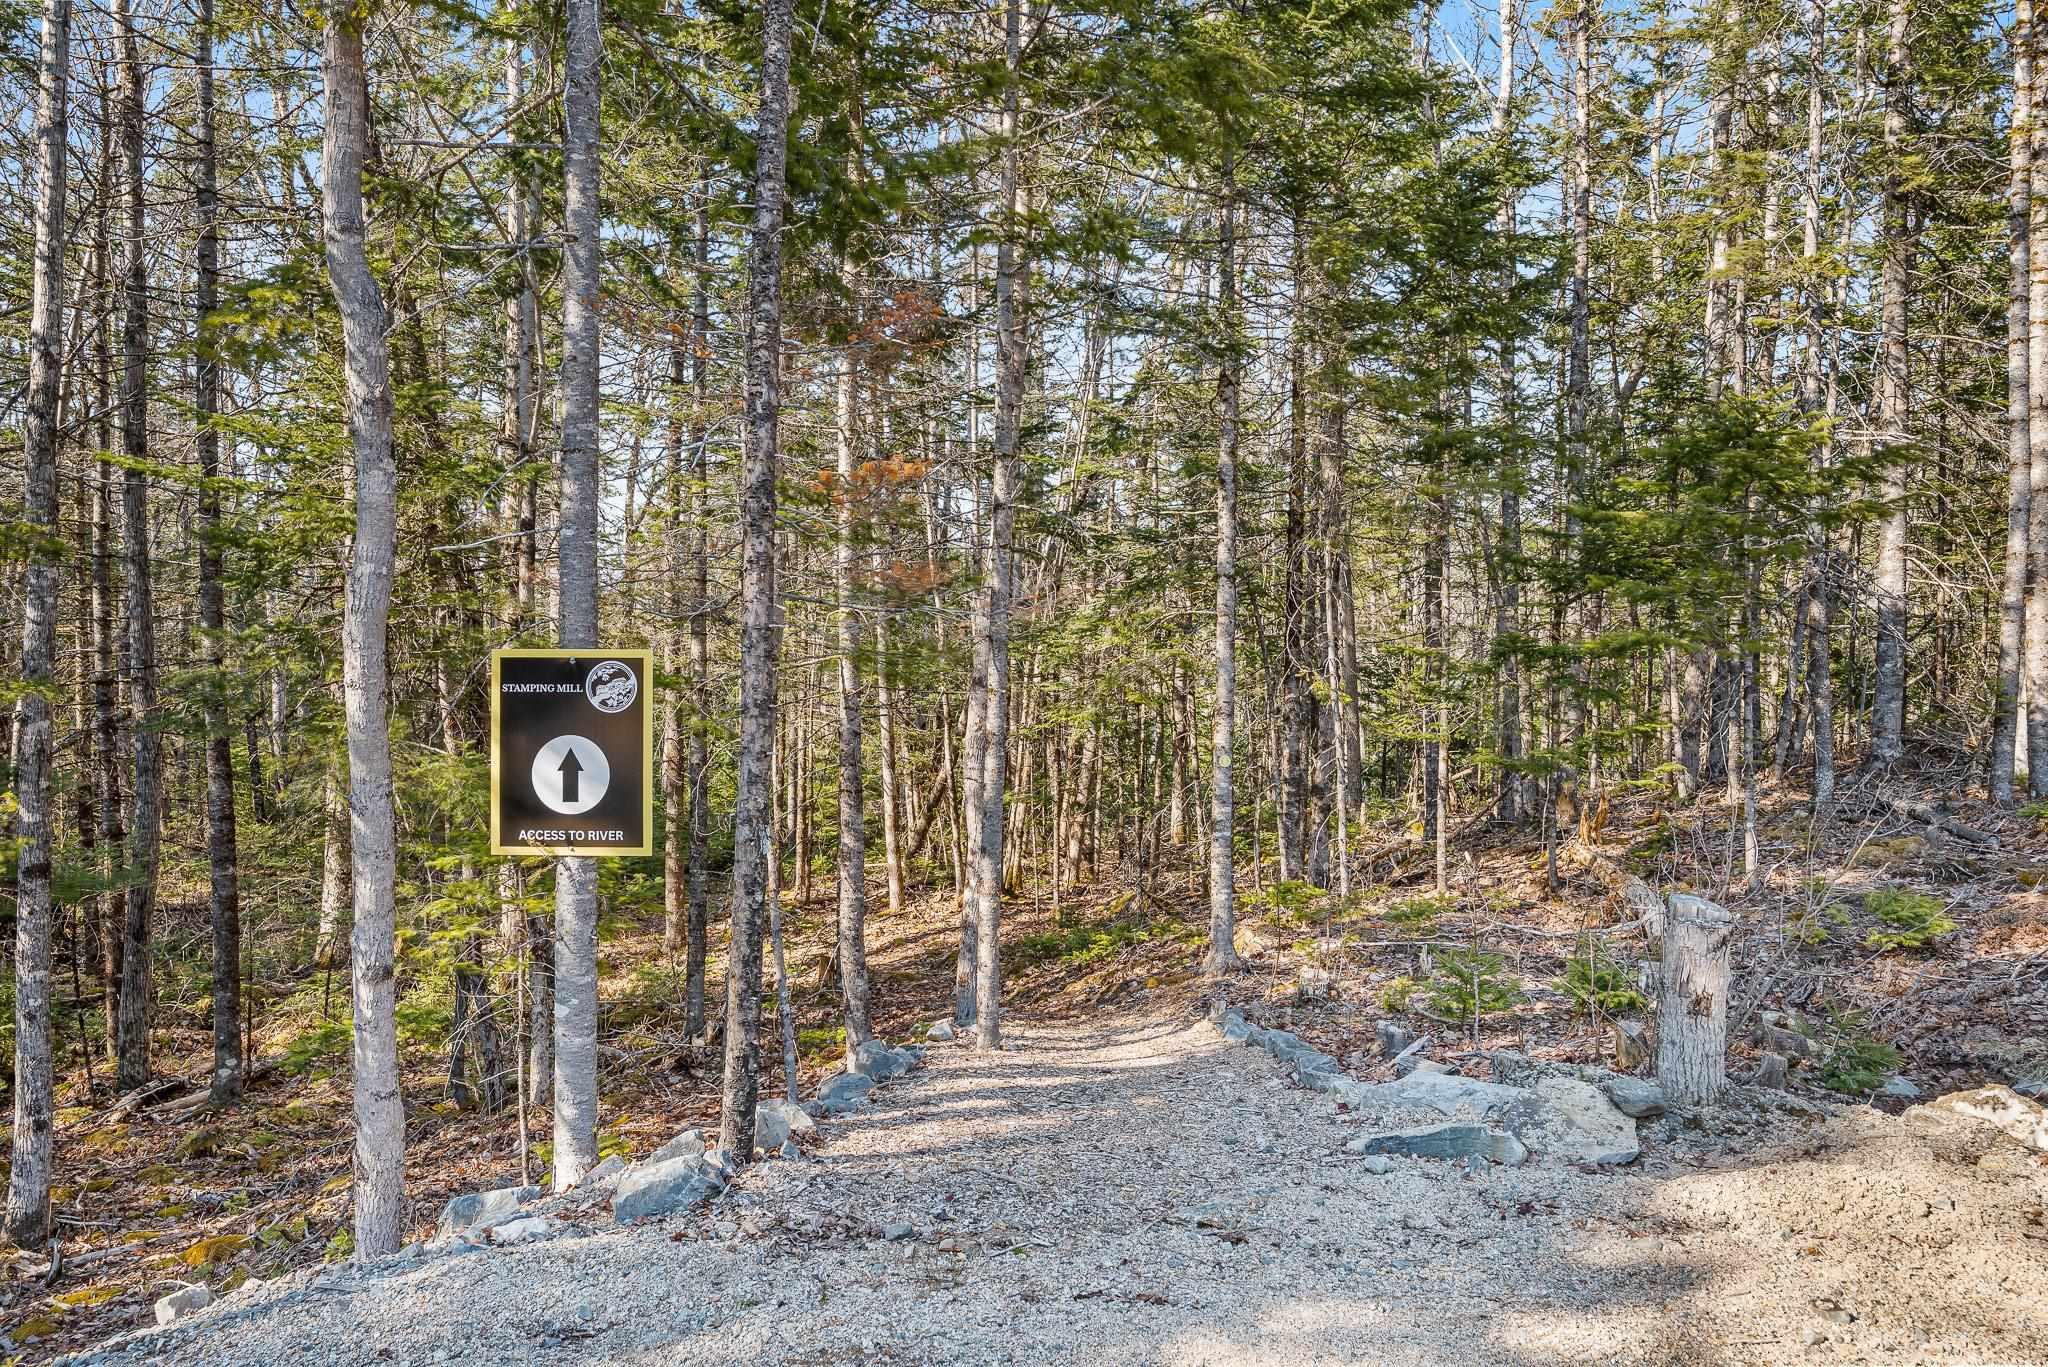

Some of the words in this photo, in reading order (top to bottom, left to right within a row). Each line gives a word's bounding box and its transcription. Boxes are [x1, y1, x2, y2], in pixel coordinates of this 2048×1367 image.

[502, 683, 555, 693] STAMPING
[556, 683, 583, 693] MILL
[518, 830, 565, 841] ACCESS
[568, 830, 585, 841] TO
[588, 830, 624, 841] RIVER
